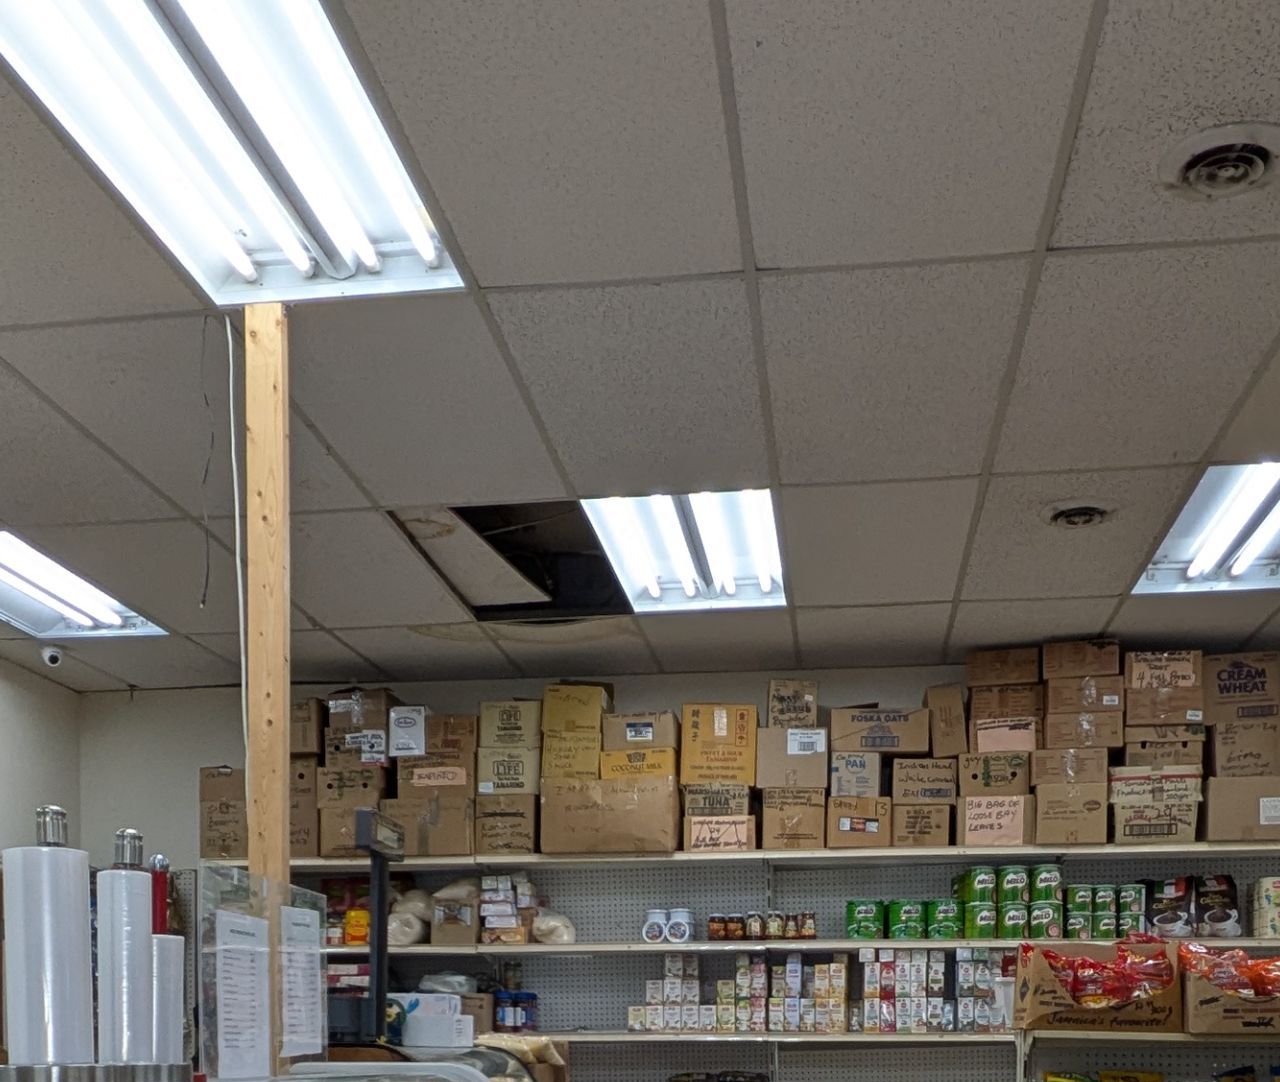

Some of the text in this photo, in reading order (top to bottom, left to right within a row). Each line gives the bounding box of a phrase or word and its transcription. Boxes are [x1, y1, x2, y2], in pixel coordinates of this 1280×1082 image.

[1217, 668, 1266, 681] CREAM
[1219, 681, 1266, 694] WHEAT
[845, 759, 867, 769] PAN
[702, 796, 731, 807] TUNA
[985, 800, 1006, 809] BAG
